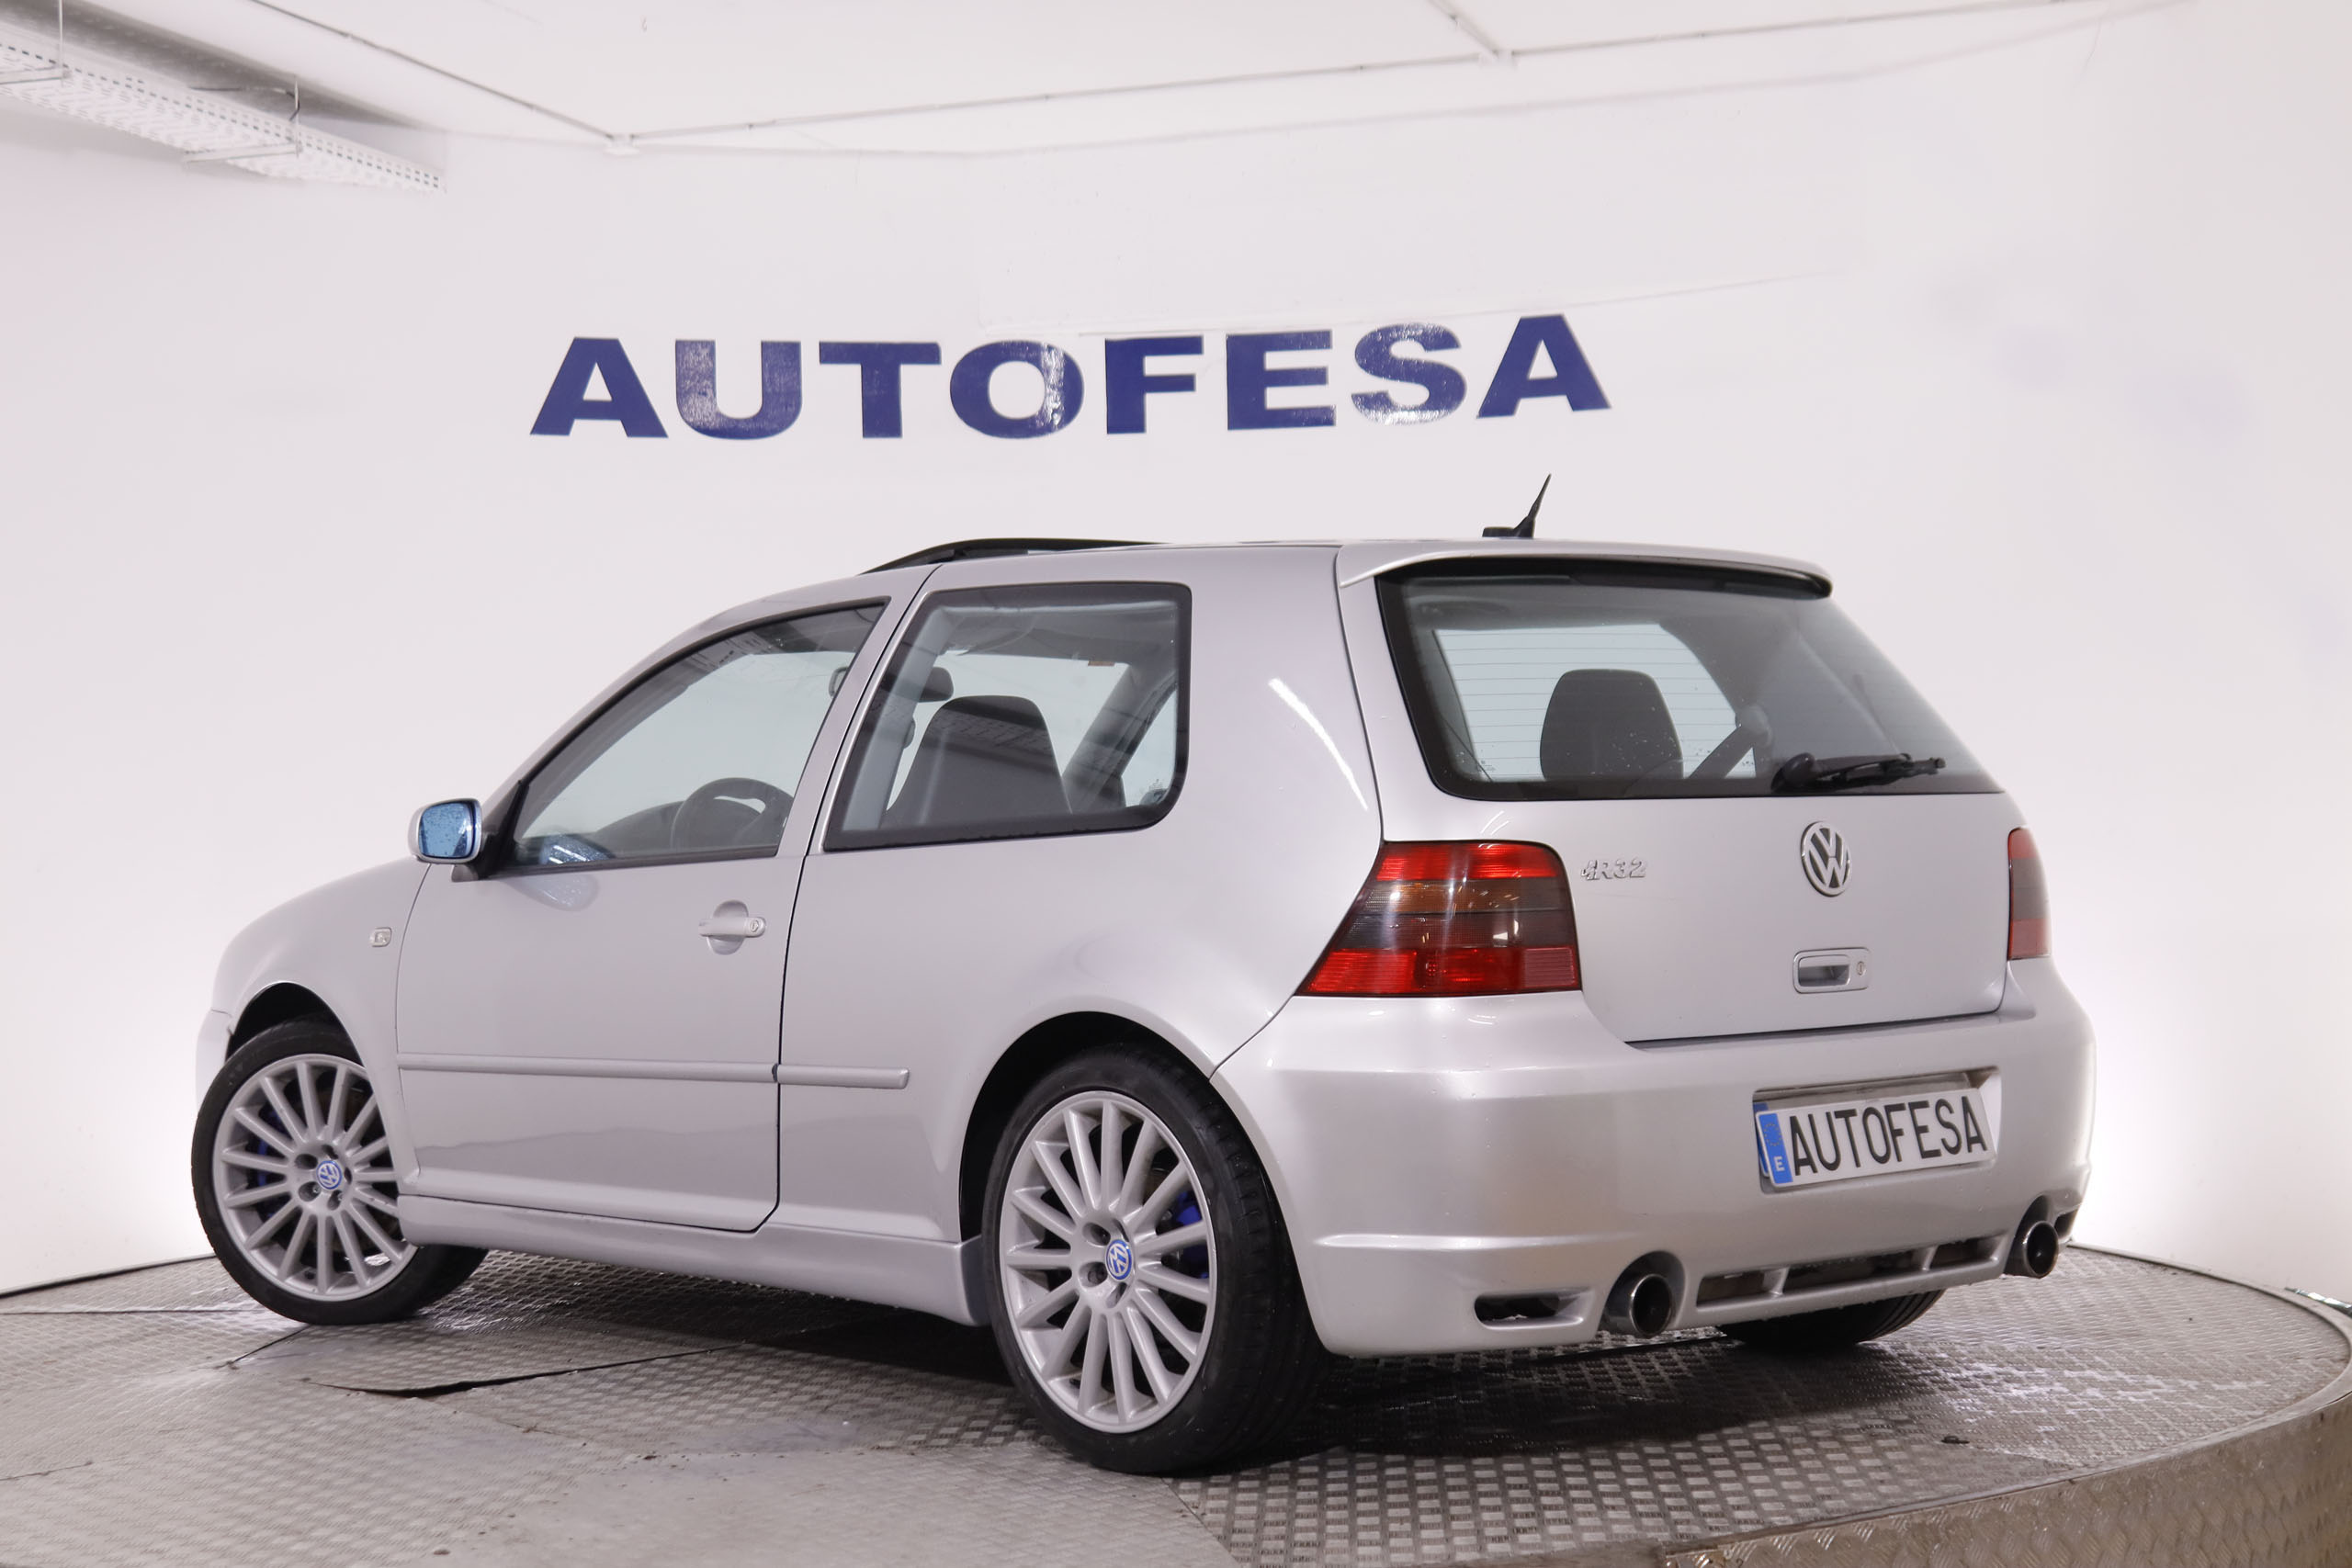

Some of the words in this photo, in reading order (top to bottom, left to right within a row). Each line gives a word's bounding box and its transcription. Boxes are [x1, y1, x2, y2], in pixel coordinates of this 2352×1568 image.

[530, 313, 1611, 440] AUTOFESA
[1774, 1156, 1785, 1172] E
[1790, 1096, 1988, 1176] AUTOFESA
